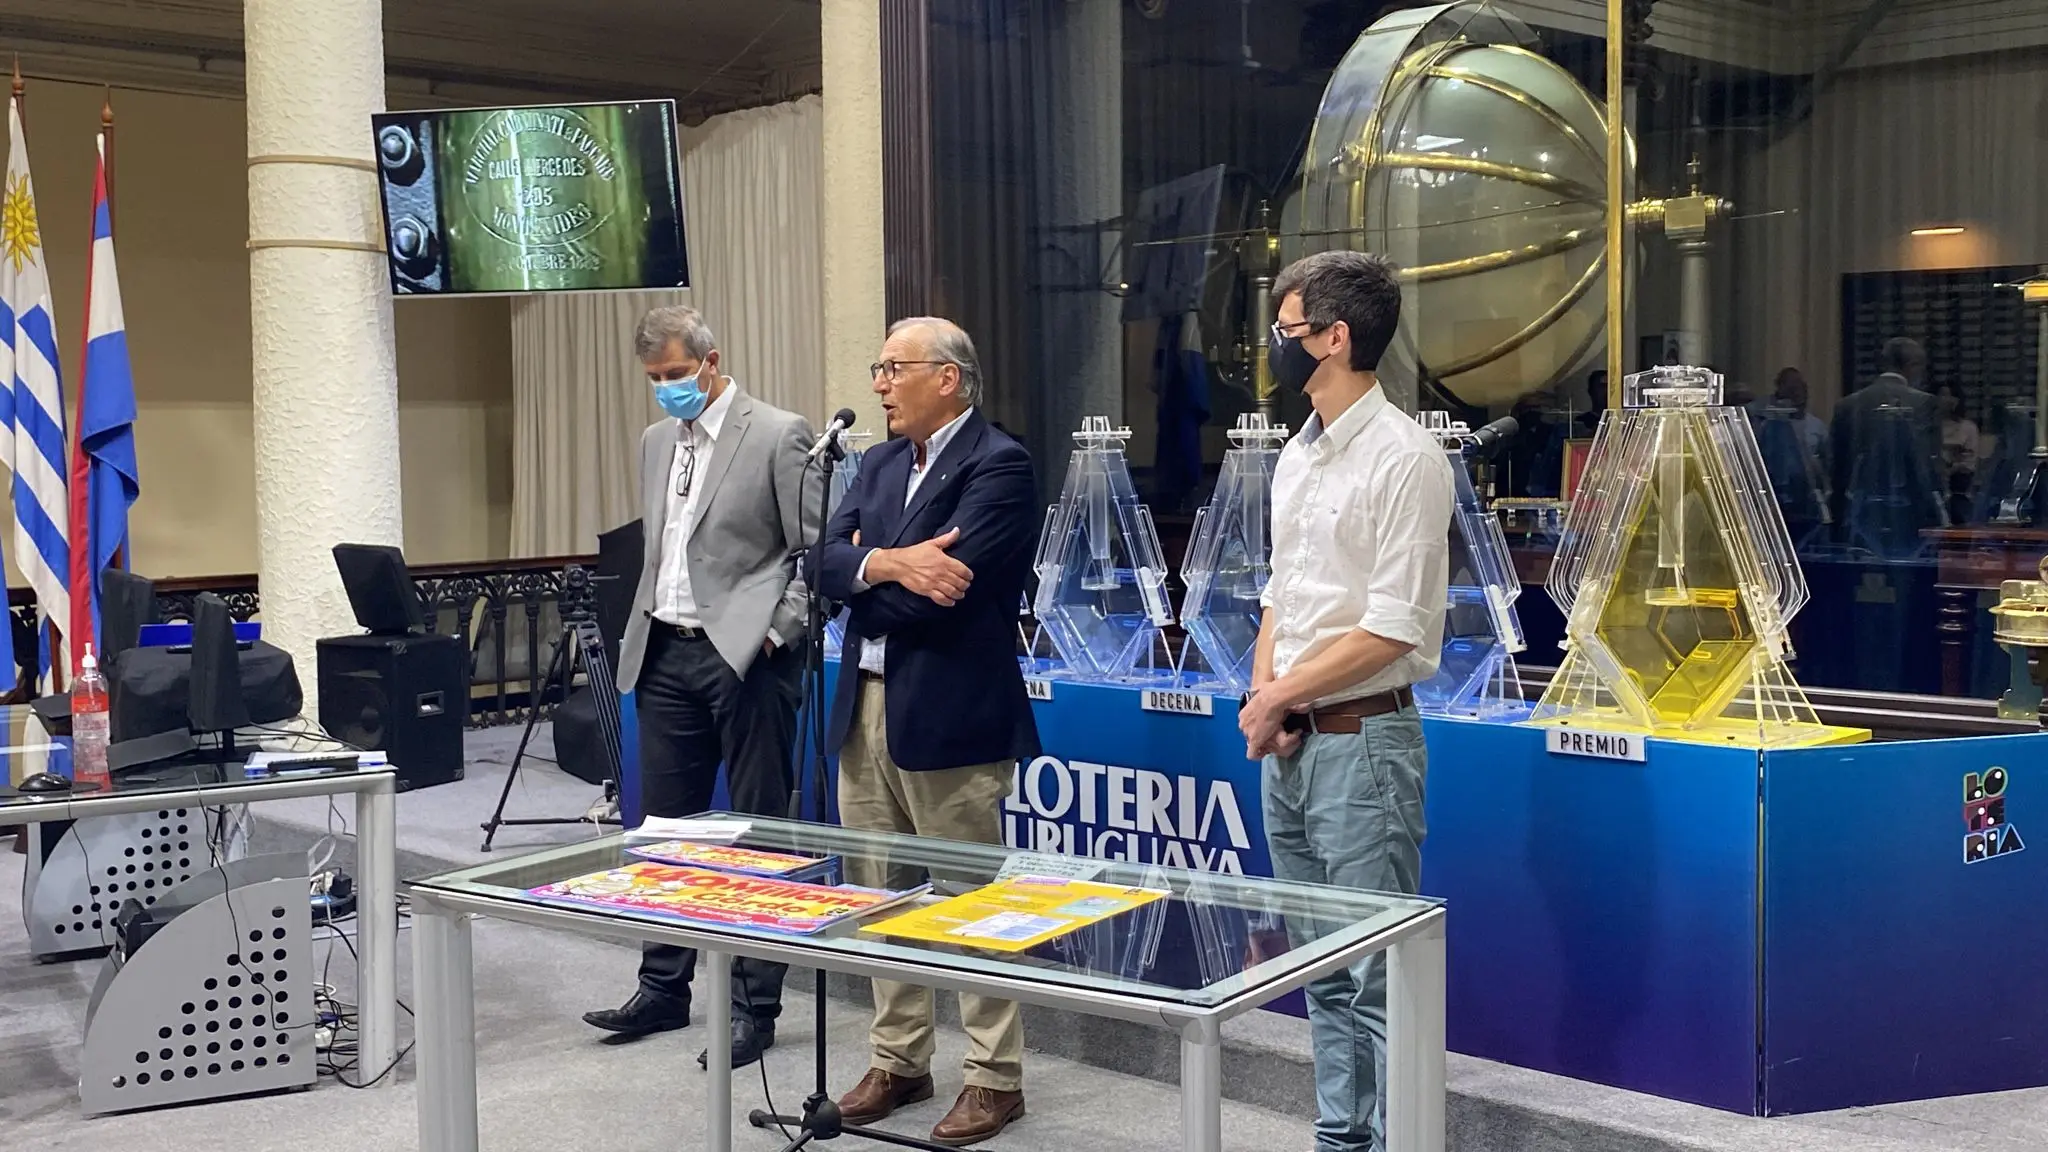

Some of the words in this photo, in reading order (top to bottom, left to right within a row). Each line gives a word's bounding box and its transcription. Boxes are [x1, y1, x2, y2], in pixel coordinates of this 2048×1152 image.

[488, 157, 521, 180] CALLE
[523, 156, 587, 178] MERCEDES
[1150, 691, 1202, 712] DECENA
[1560, 732, 1628, 756] PREMIO
[1005, 755, 1251, 850] LOTERIA
[1005, 814, 1244, 876] URUGUAYA
[692, 892, 808, 914] Gordo
